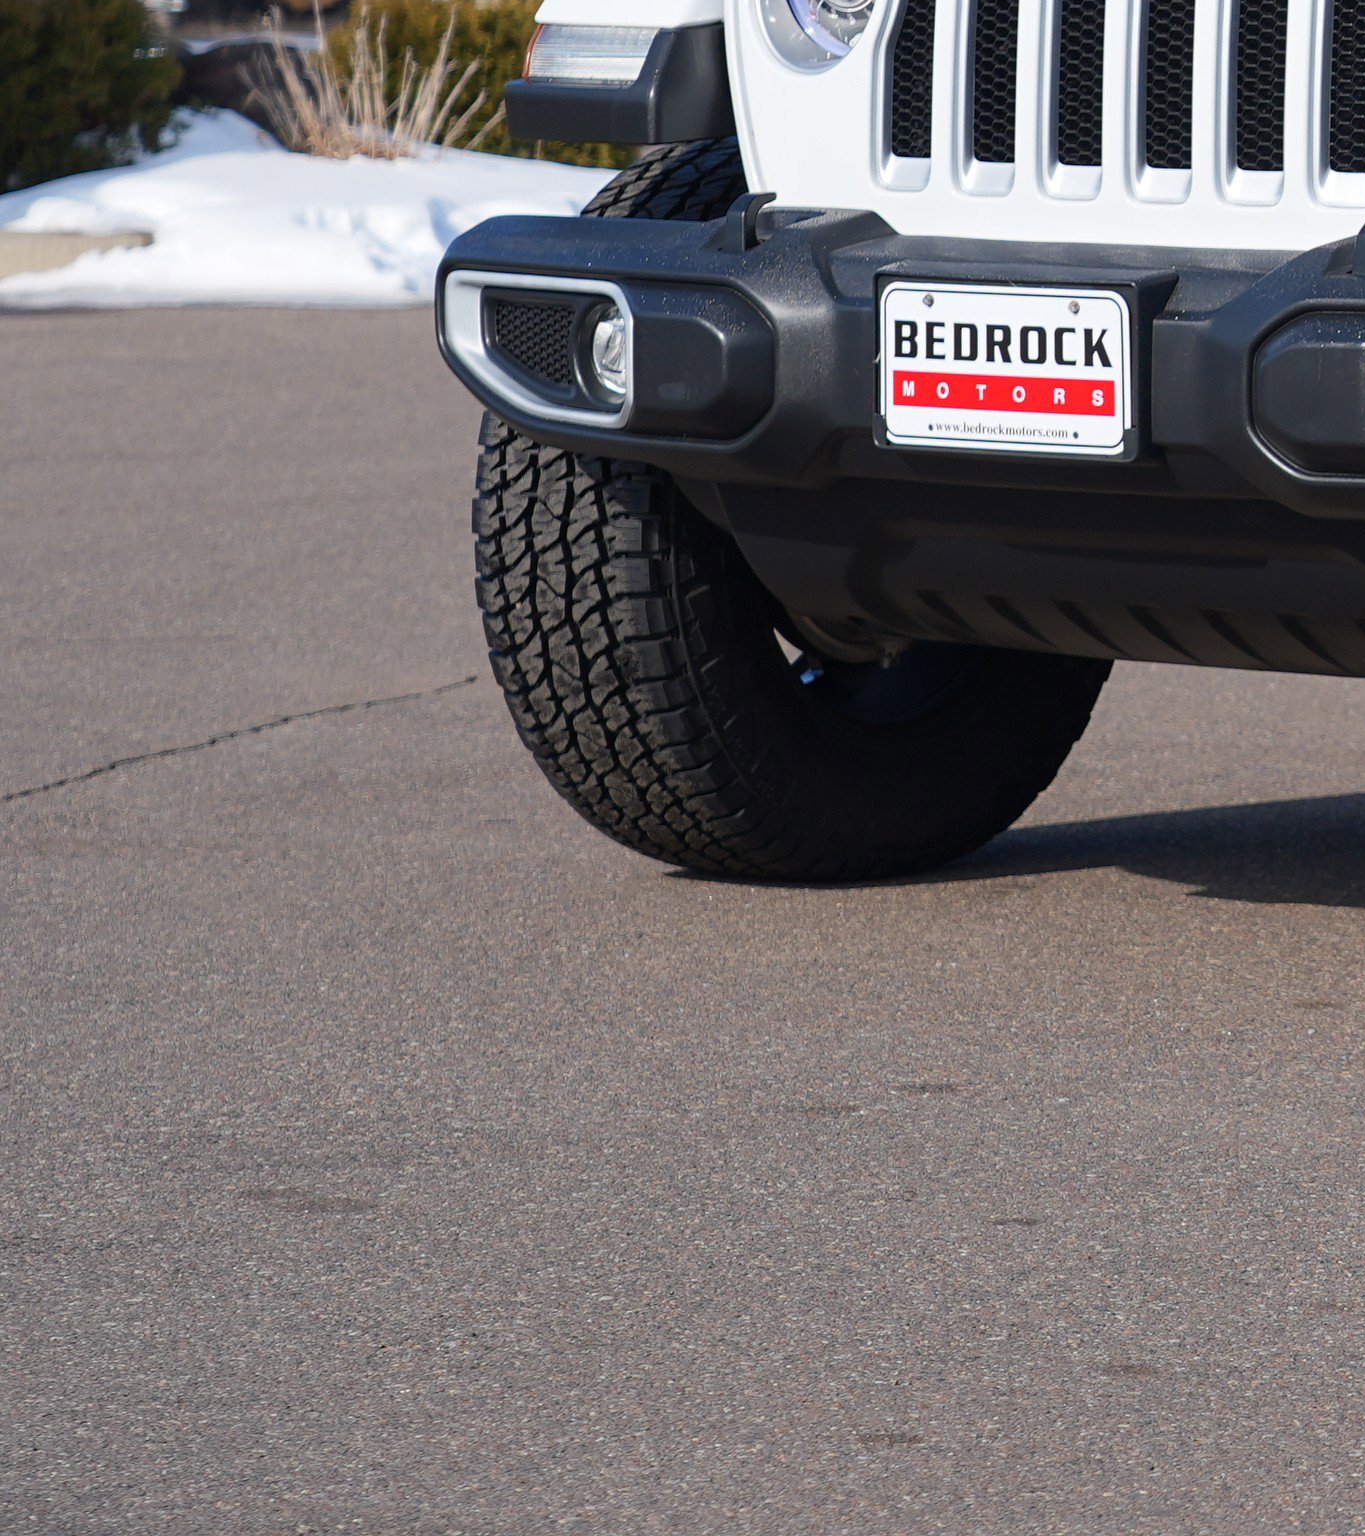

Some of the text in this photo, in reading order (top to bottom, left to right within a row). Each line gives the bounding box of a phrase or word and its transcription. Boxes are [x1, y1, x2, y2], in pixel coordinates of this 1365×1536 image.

[894, 319, 1113, 368] BEDROCK
[902, 380, 1105, 407] MOTORS
[935, 421, 1069, 440] www.bedrockmotors.com
